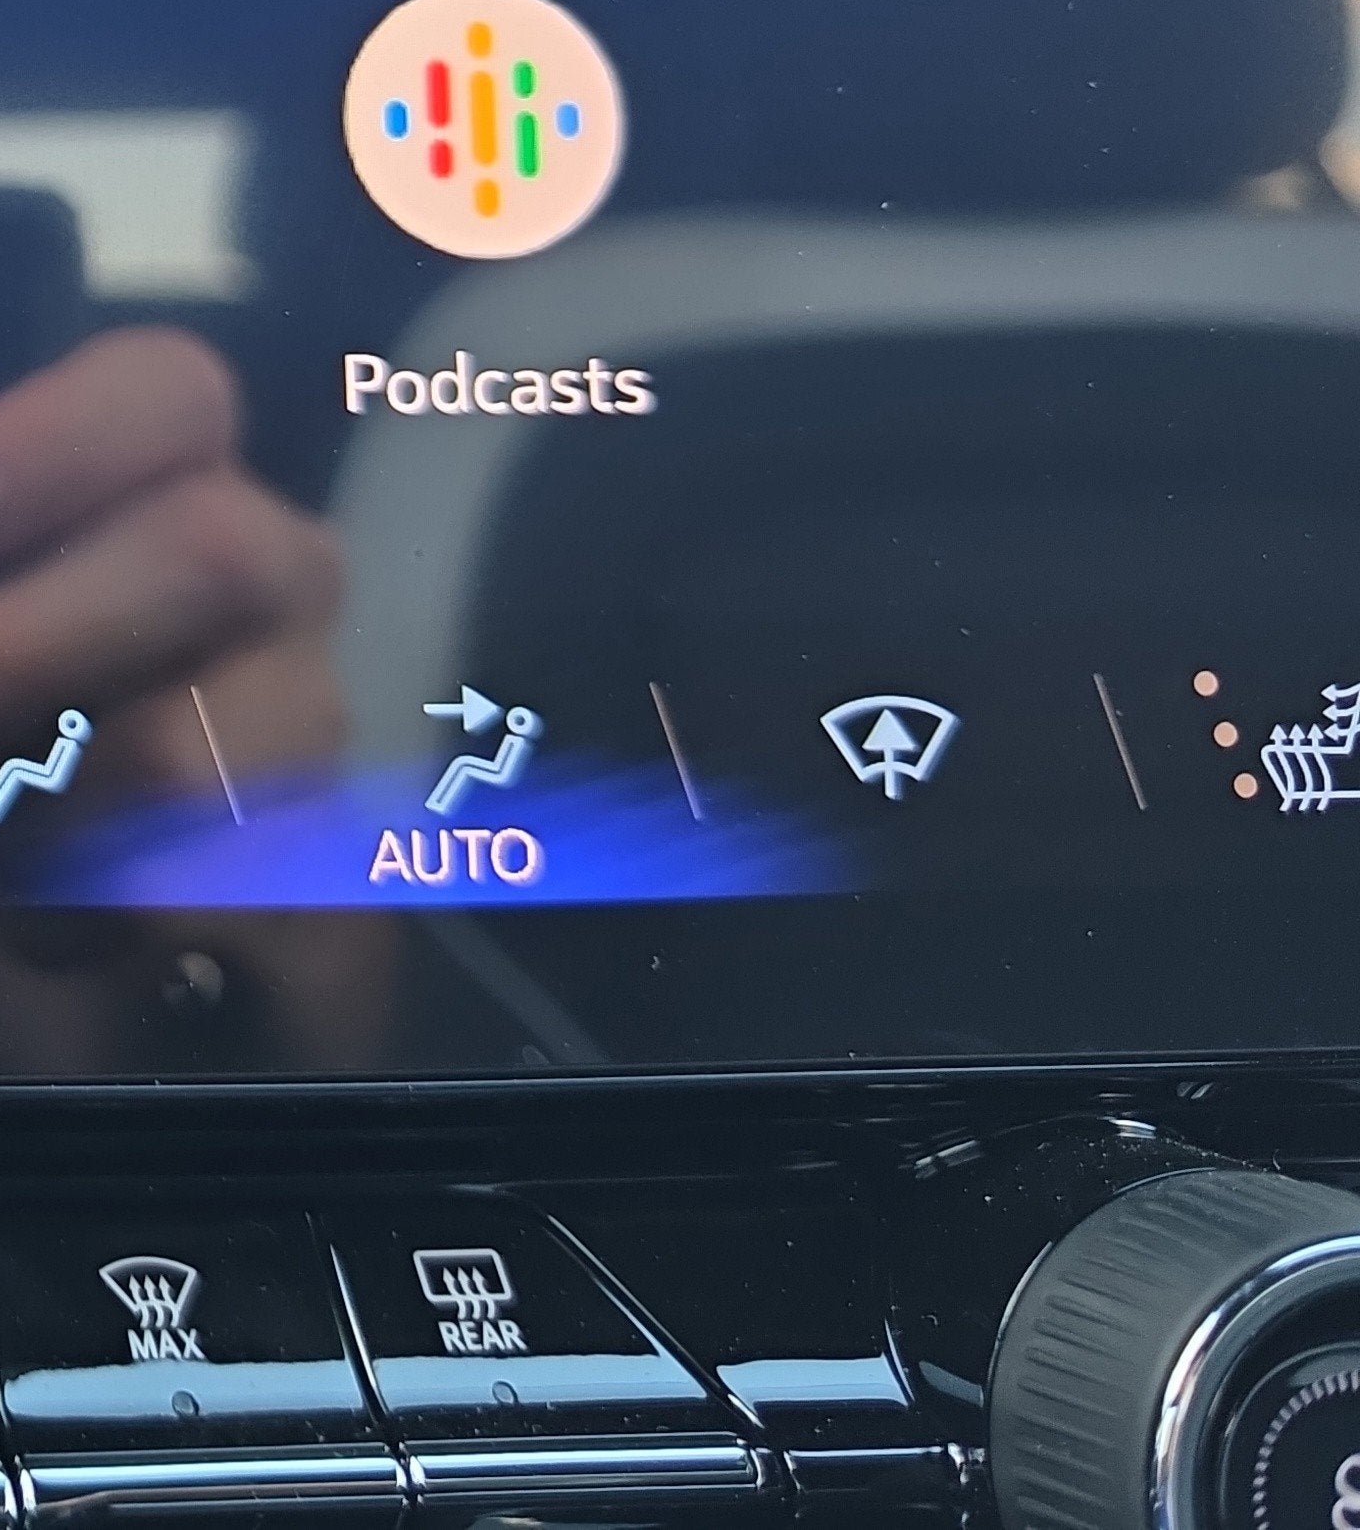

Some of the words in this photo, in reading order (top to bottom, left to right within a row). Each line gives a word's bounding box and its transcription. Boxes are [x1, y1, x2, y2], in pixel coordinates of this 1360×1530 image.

[342, 353, 654, 416] Podcasts
[368, 826, 542, 886] AUTO
[128, 1328, 205, 1362] MAX
[440, 1320, 527, 1354] REAR
